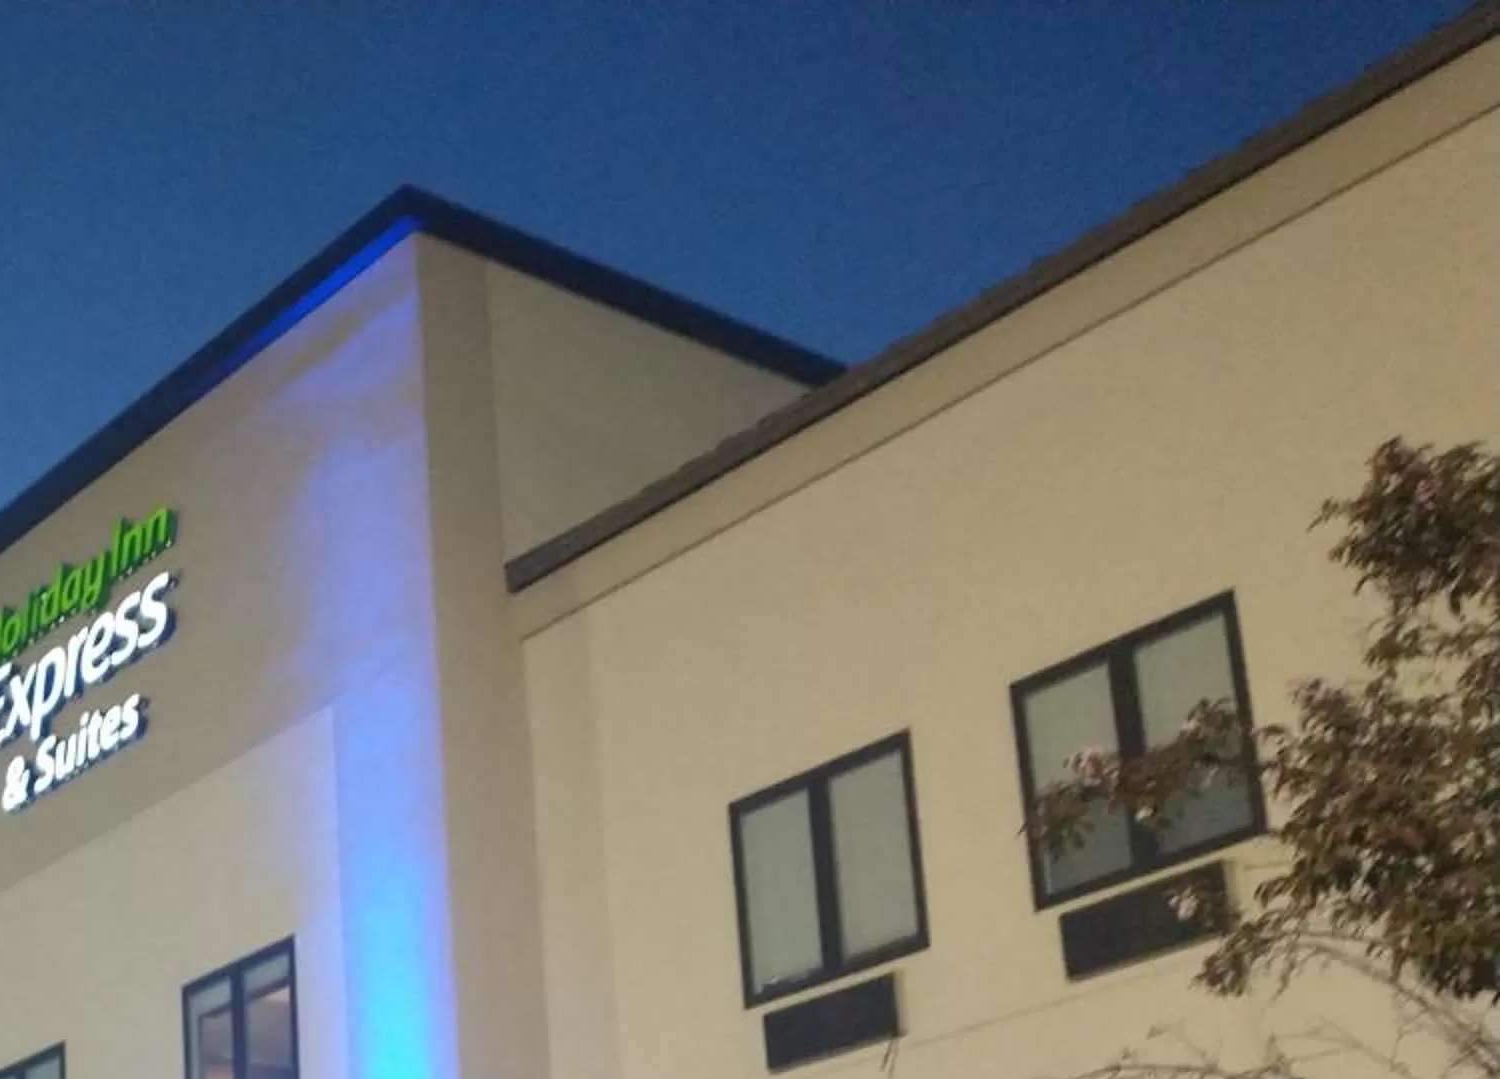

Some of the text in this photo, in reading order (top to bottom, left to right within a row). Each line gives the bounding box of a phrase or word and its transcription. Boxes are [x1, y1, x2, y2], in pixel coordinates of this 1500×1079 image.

[111, 507, 169, 577] Inn
[2, 693, 141, 813] & Suites
